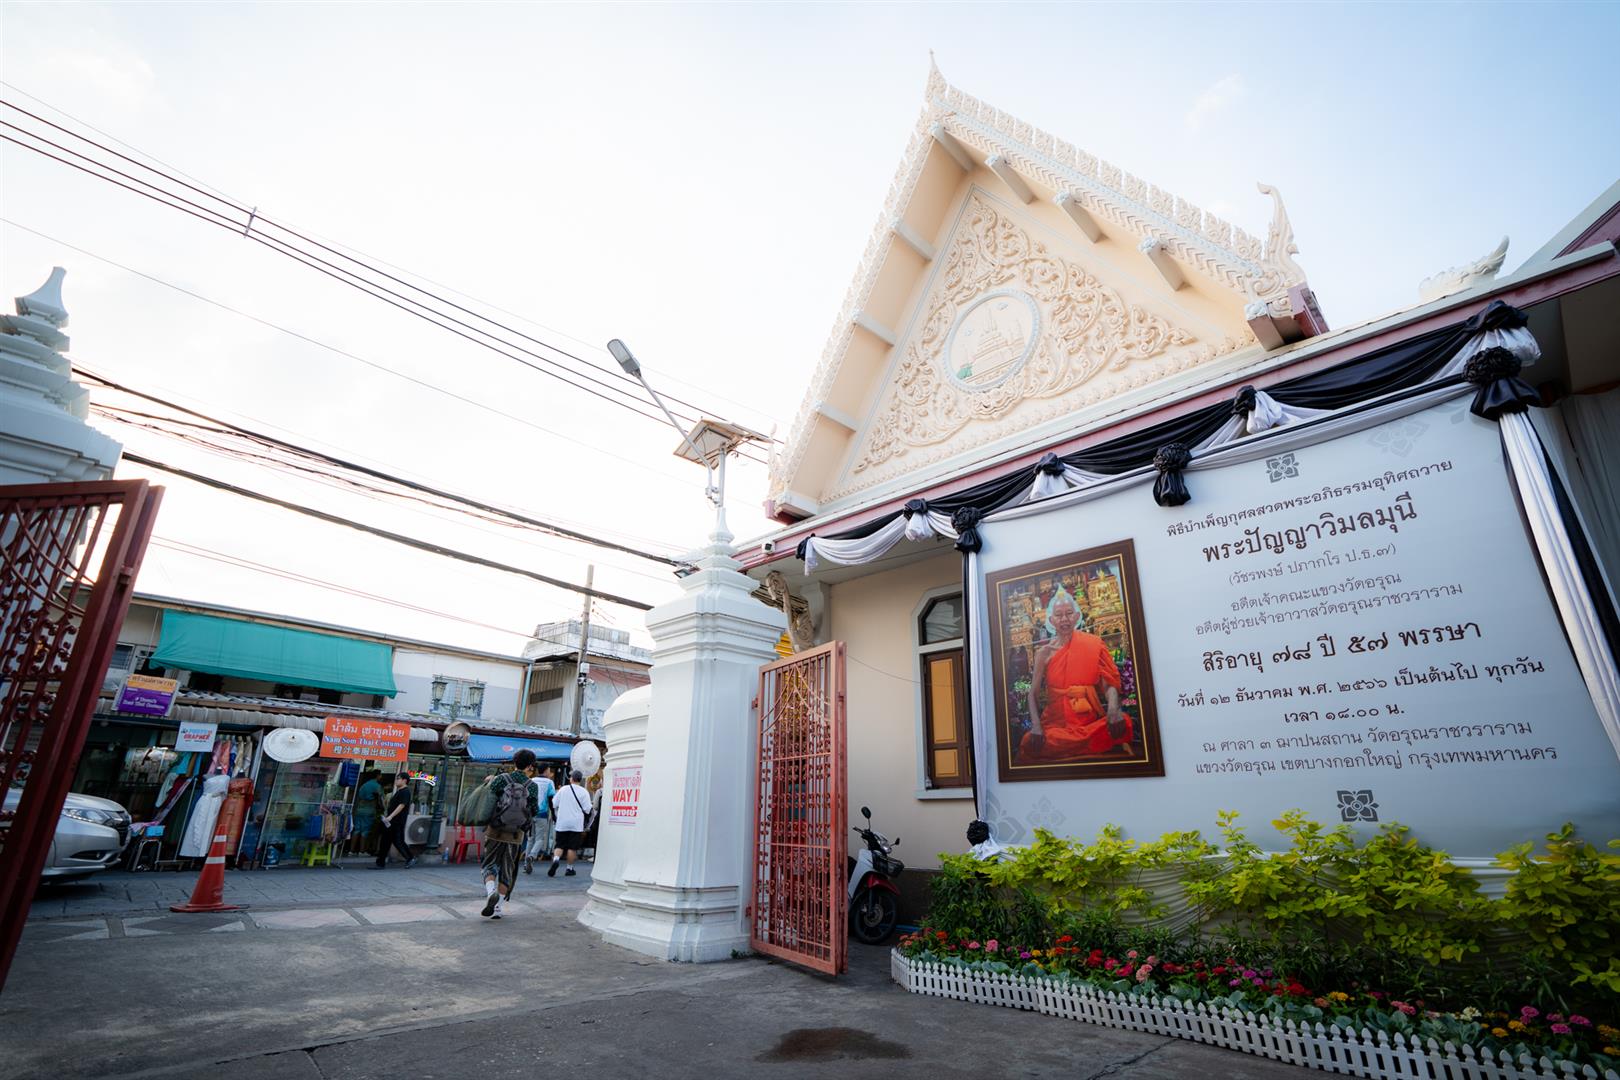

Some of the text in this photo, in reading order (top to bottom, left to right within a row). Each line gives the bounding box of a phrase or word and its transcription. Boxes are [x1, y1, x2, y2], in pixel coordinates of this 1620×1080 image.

[1202, 491, 1418, 563] พระปัญญาวิมลมุนี
[1229, 543, 1396, 586] (วัชรพงษ์ ปภากโร ป.ธ.๗)
[1196, 584, 1463, 635] อดีตผู้ช่วยเจ้าอาวาสวัดอรุณราชวราราม
[1230, 573, 1402, 612] อดีตเจ้าคณะแขวงวัดอรุณ
[1202, 622, 1482, 674] สิริอายุ ๗๘ ปี ๕๗ พรรษา
[1177, 656, 1545, 708] วันที่ ๑๒ ธันวาคม พ.ศ. ๒๕๖๖ เป็นต้นไป ทุกวัน
[1284, 704, 1405, 723] เวลา ๑๘.๐๐ น.
[359, 738, 374, 746] Thai
[375, 739, 406, 748] Costumes
[1202, 722, 1532, 753] ณ ศาลา ๓ ฌาปนสถาน วัดอรุณราชวราราม
[1196, 747, 1557, 776] แขวงวัดอรุณ เขตบางกอกใหญ่ กรุงเทพมหานคร
[612, 789, 632, 802] WAY
